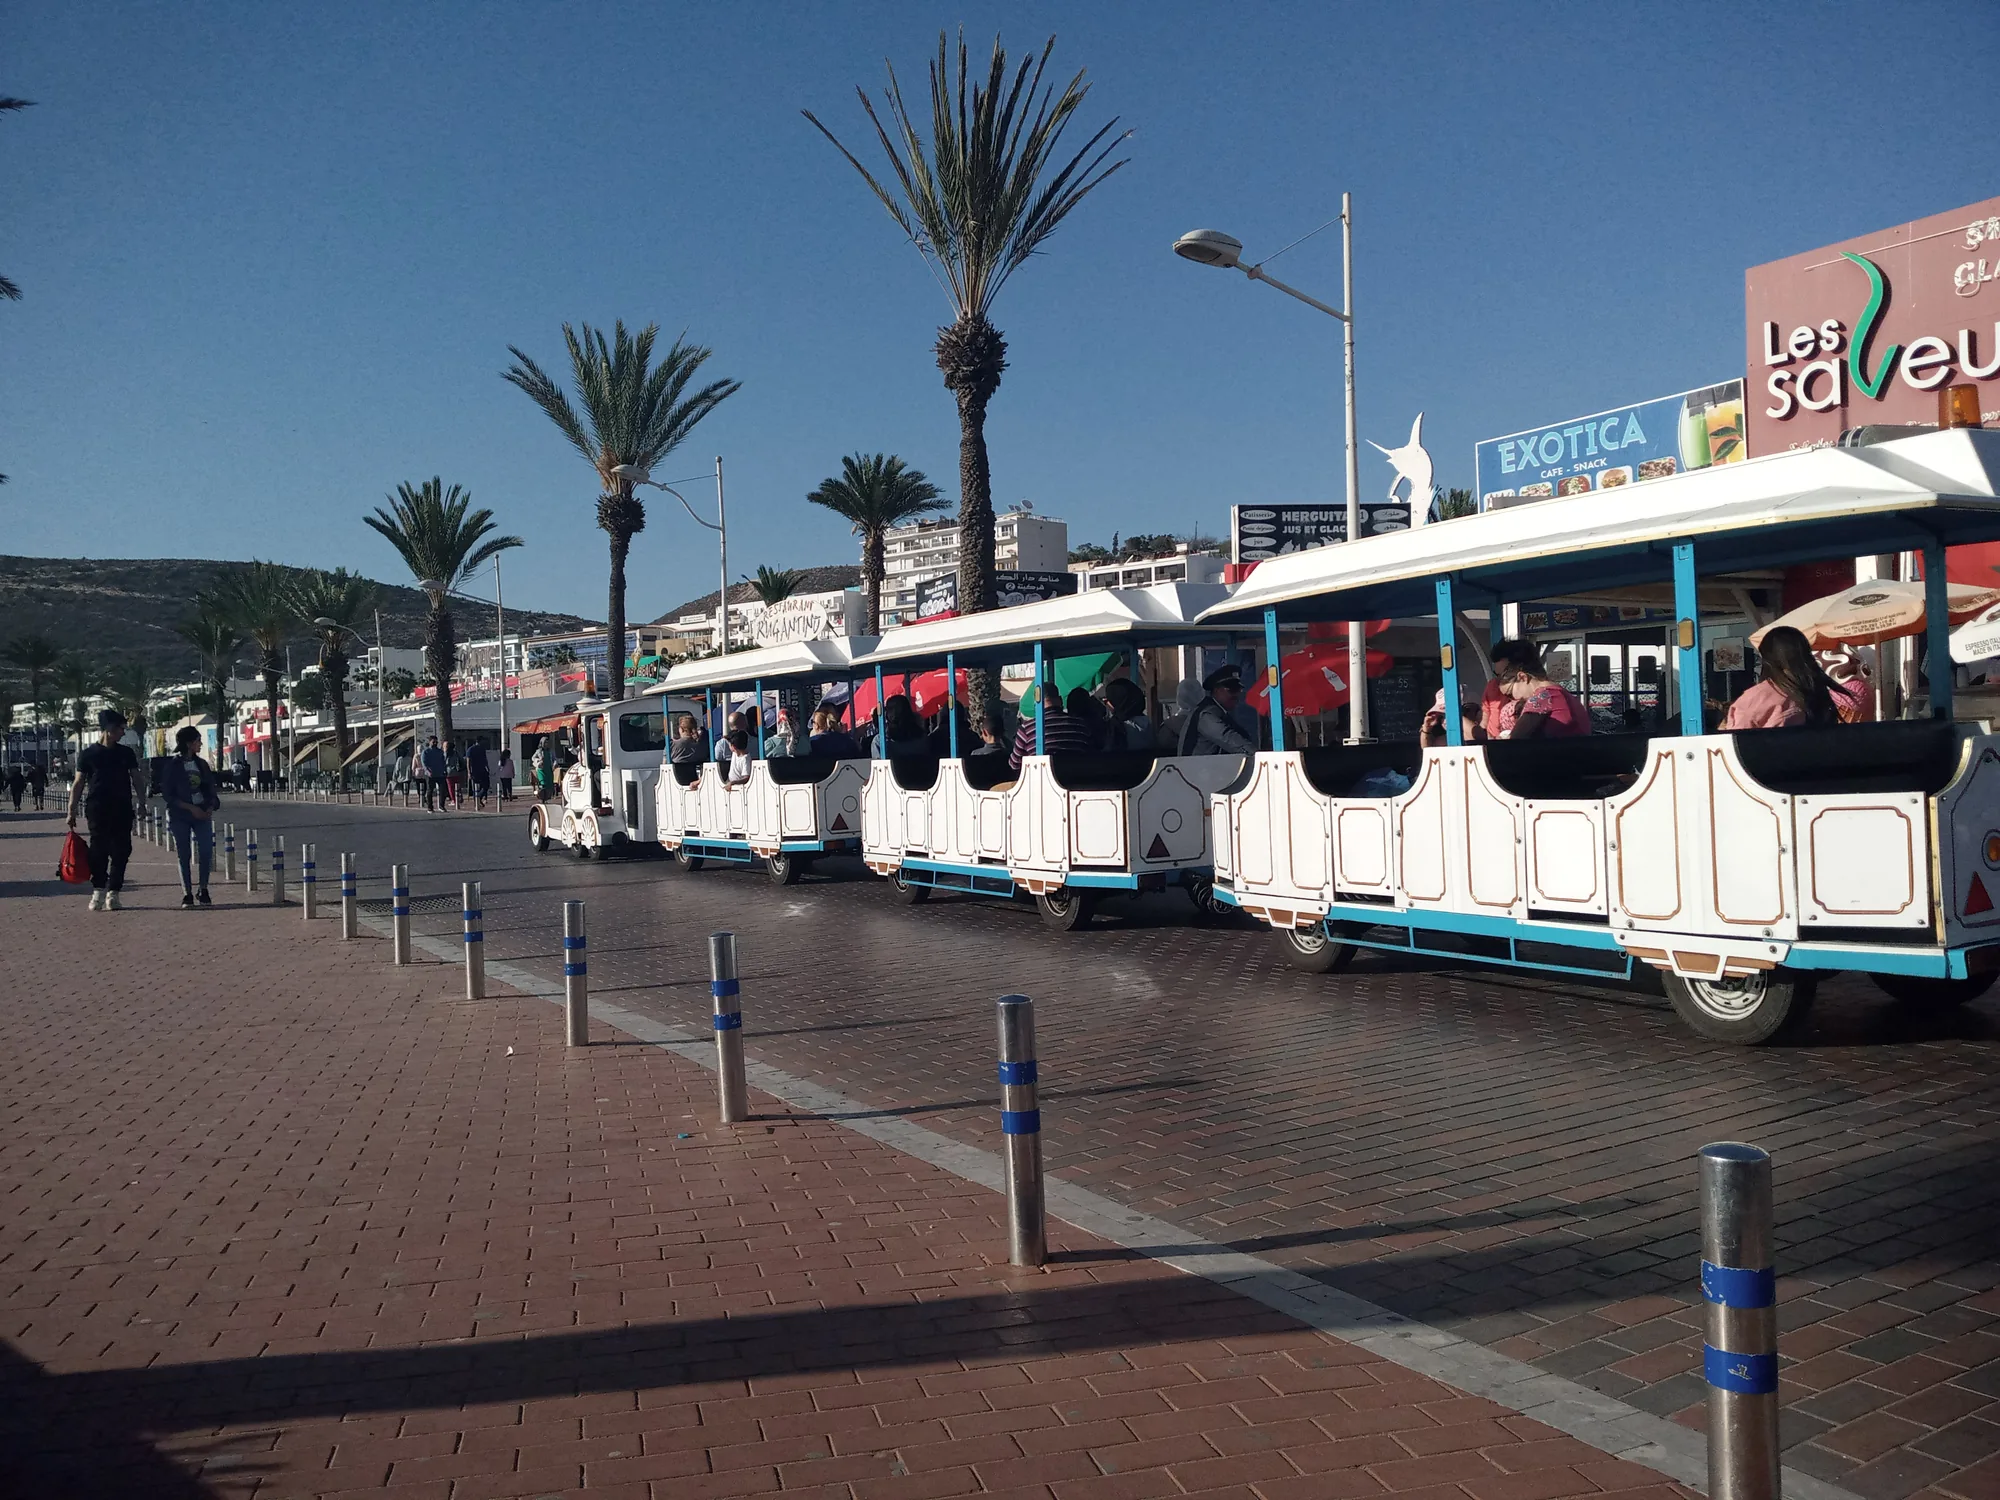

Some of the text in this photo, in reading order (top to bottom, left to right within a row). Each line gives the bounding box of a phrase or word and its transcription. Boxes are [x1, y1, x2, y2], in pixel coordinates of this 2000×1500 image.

[1764, 319, 1840, 366] Les
[1498, 411, 1647, 474] EXOTICA
[1540, 467, 1564, 479] CAFE
[1573, 457, 1608, 472] SNACK
[1282, 525, 1347, 534] JUS ET GLAC
[1965, 639, 1989, 651] ESPRESSO
[1972, 647, 1987, 656] MADE
